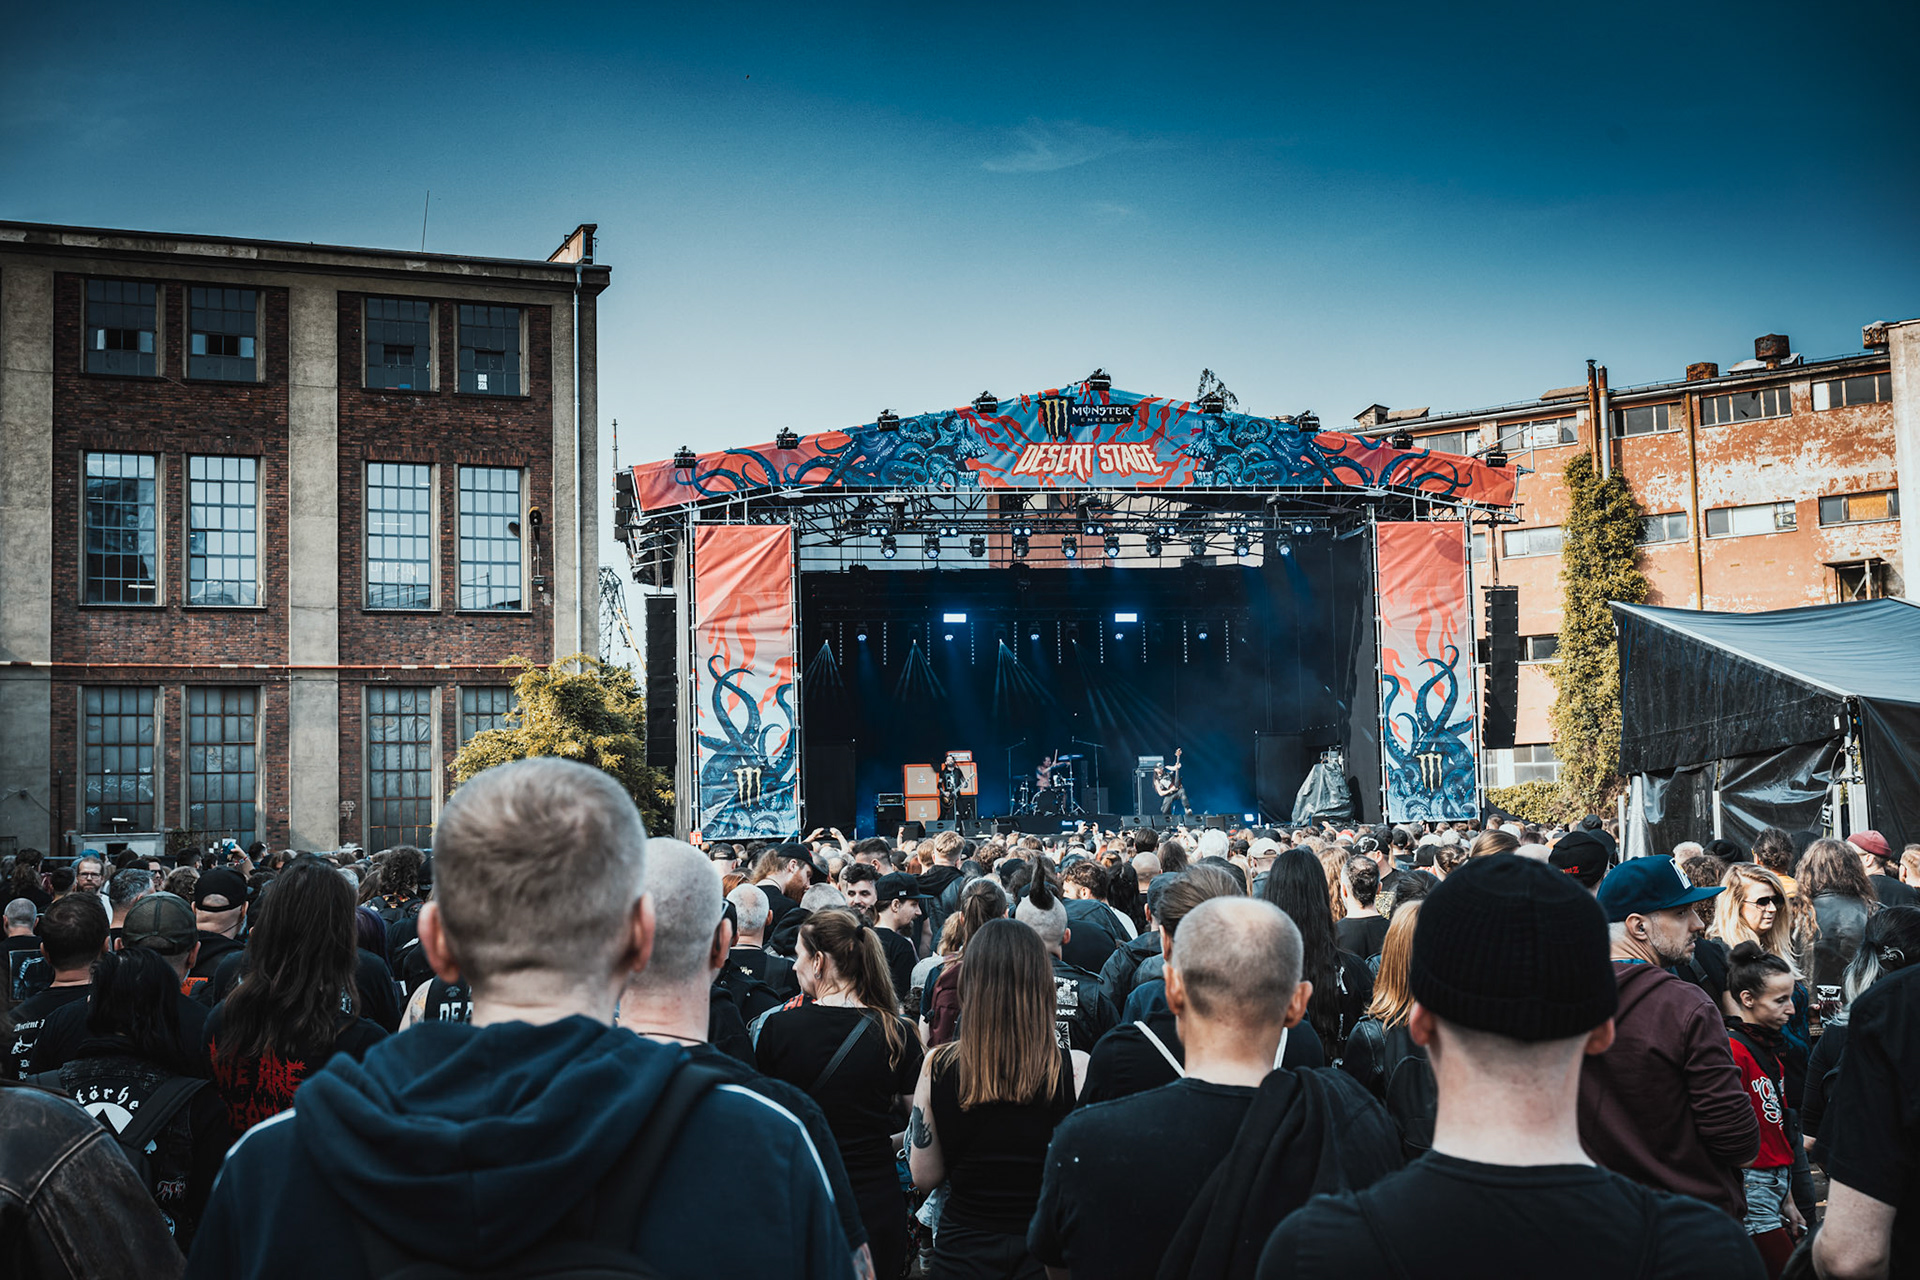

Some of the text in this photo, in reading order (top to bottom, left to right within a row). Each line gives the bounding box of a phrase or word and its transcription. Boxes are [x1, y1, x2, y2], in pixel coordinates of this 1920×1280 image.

[1072, 405, 1132, 416] MONSTER
[1013, 443, 1164, 482] DESERT STAGE
